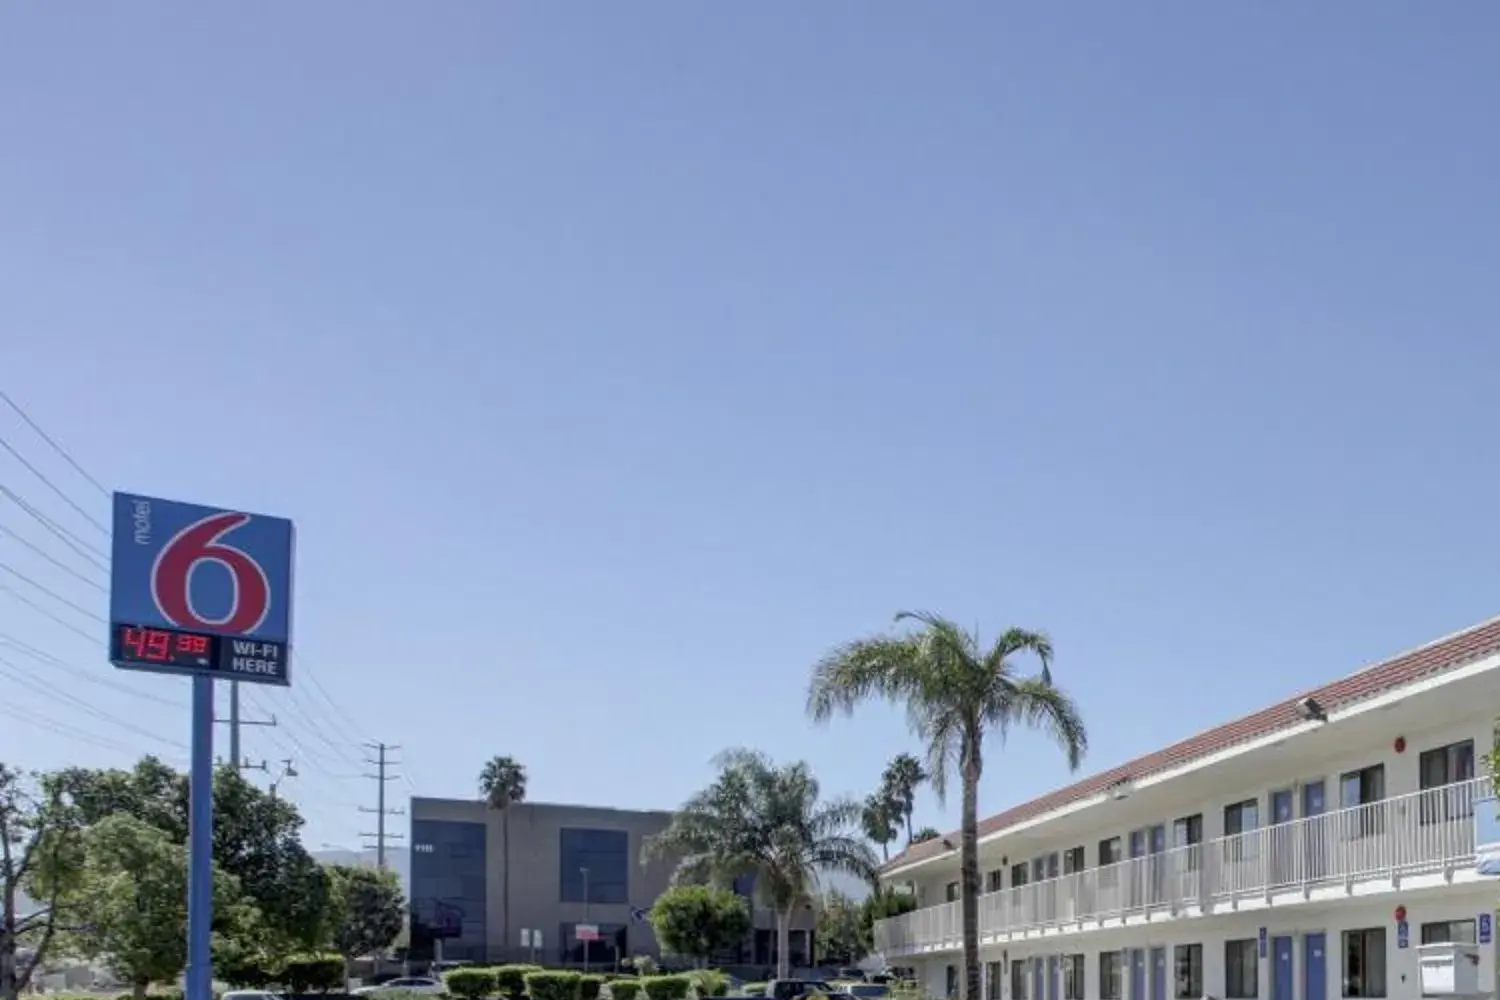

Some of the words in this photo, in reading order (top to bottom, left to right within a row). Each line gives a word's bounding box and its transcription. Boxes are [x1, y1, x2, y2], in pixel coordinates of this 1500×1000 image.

[150, 511, 270, 635] 6
[232, 639, 277, 659] WI-FI
[232, 657, 277, 676] HERE
